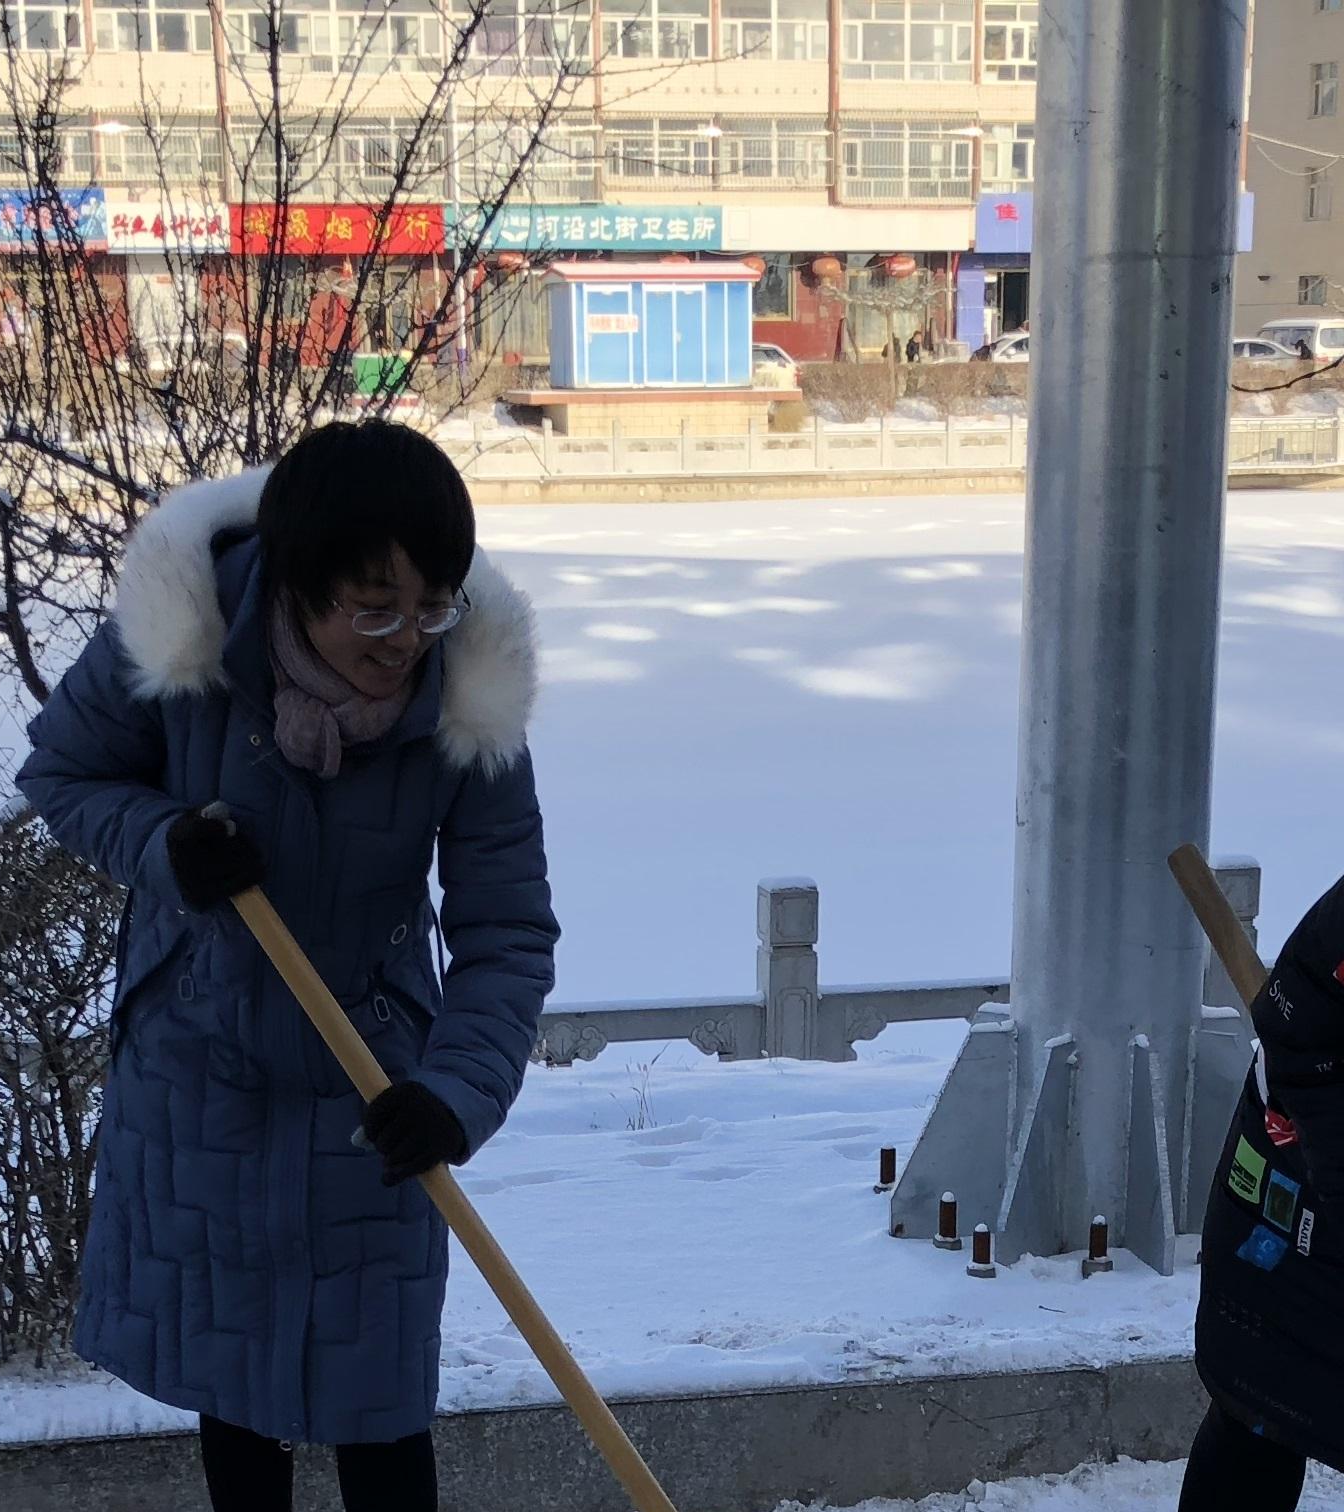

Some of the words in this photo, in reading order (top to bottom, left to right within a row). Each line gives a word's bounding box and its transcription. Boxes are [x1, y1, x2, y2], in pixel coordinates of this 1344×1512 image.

[535, 216, 716, 242] 河沿北街卫生所
